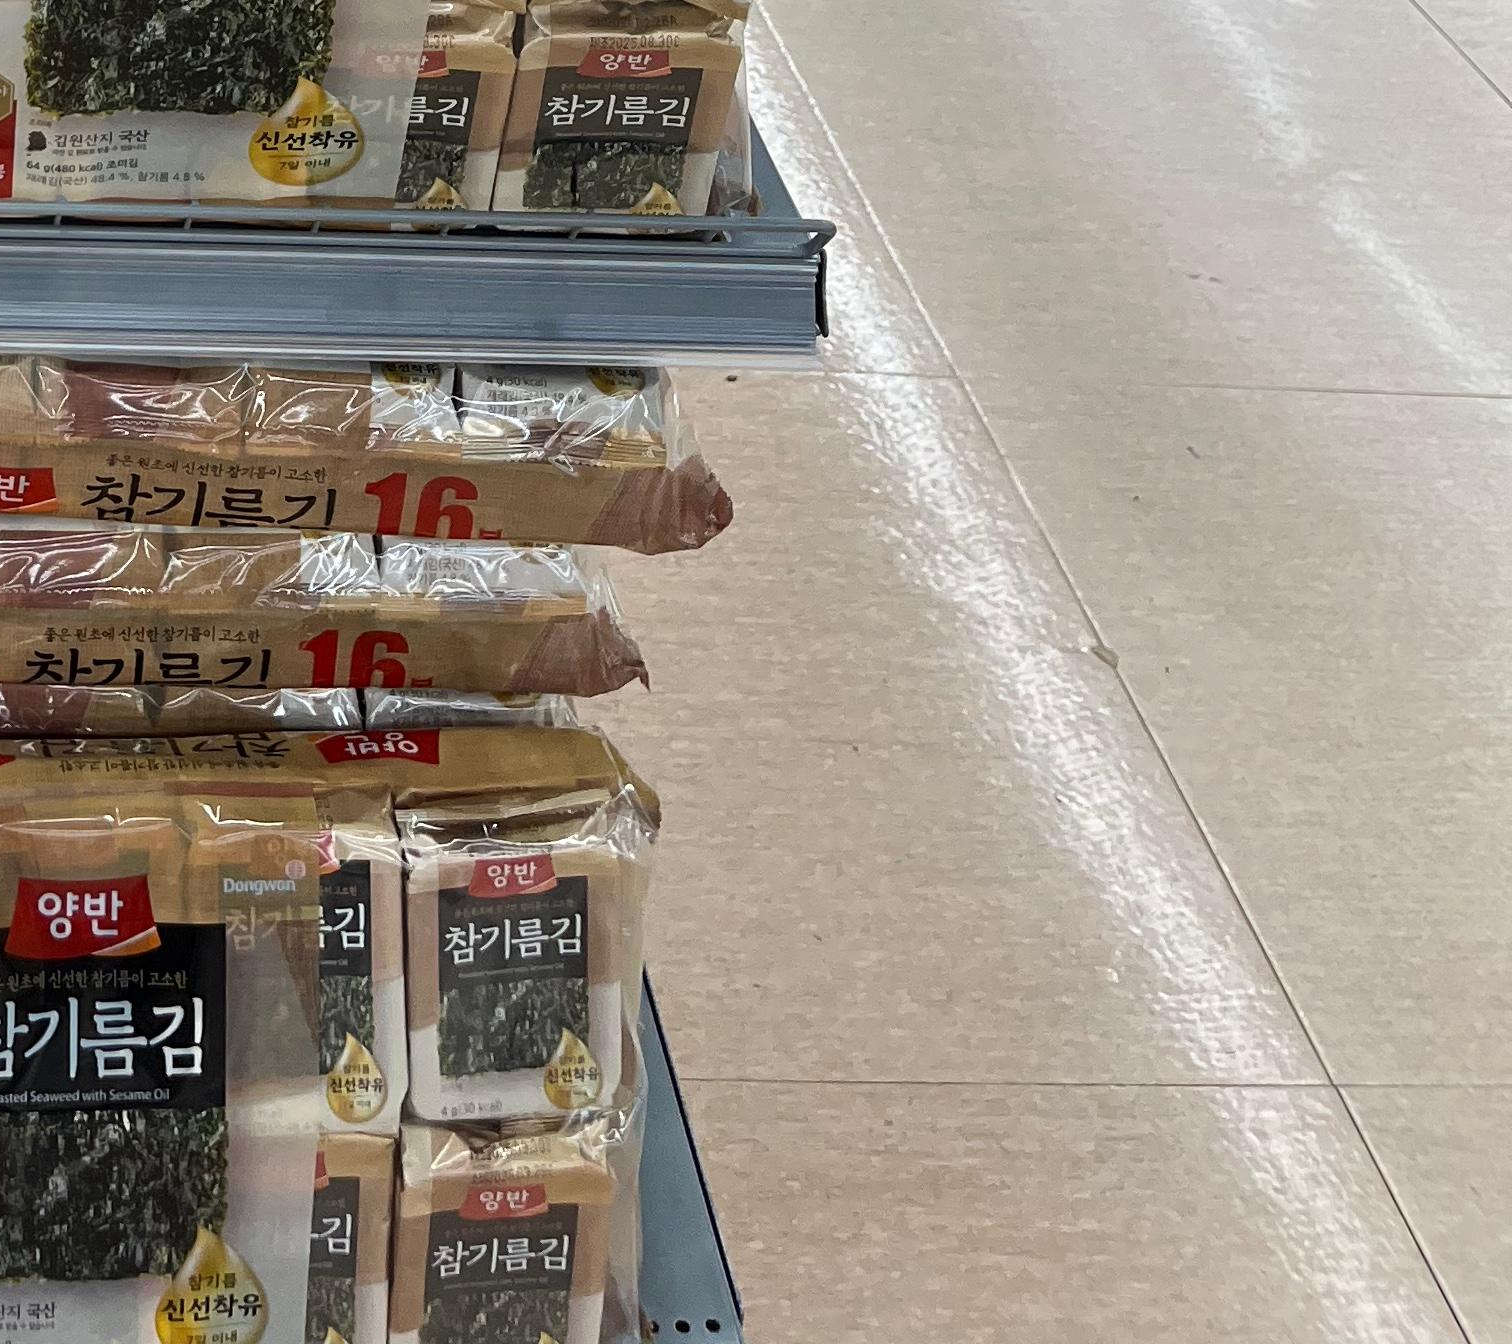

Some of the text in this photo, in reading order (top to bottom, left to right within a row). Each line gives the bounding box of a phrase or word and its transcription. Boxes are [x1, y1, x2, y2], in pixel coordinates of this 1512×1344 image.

[599, 51, 653, 73] 양반
[286, 114, 333, 131] 참기름
[545, 95, 691, 129] 참기름김
[54, 129, 150, 149] 김원산지 국산
[106, 454, 327, 484] 좋은 원초에 신선한 참기름이 고소한
[223, 876, 296, 894] Dongwon
[444, 912, 583, 965] 참기름김
[9, 971, 46, 992] 원초에
[50, 969, 87, 990] 신선한
[91, 968, 144, 990] 참기름이
[147, 967, 187, 990] 고소한
[29, 1090, 78, 1105] Seaweed
[81, 1089, 105, 1103] with
[109, 1087, 150, 1103] Sesame
[153, 1087, 170, 1102] Oil
[479, 1188, 530, 1212] 양반
[432, 1234, 571, 1278] 참기름김
[189, 1272, 237, 1291] 참기름
[27, 1301, 56, 1319] 국산
